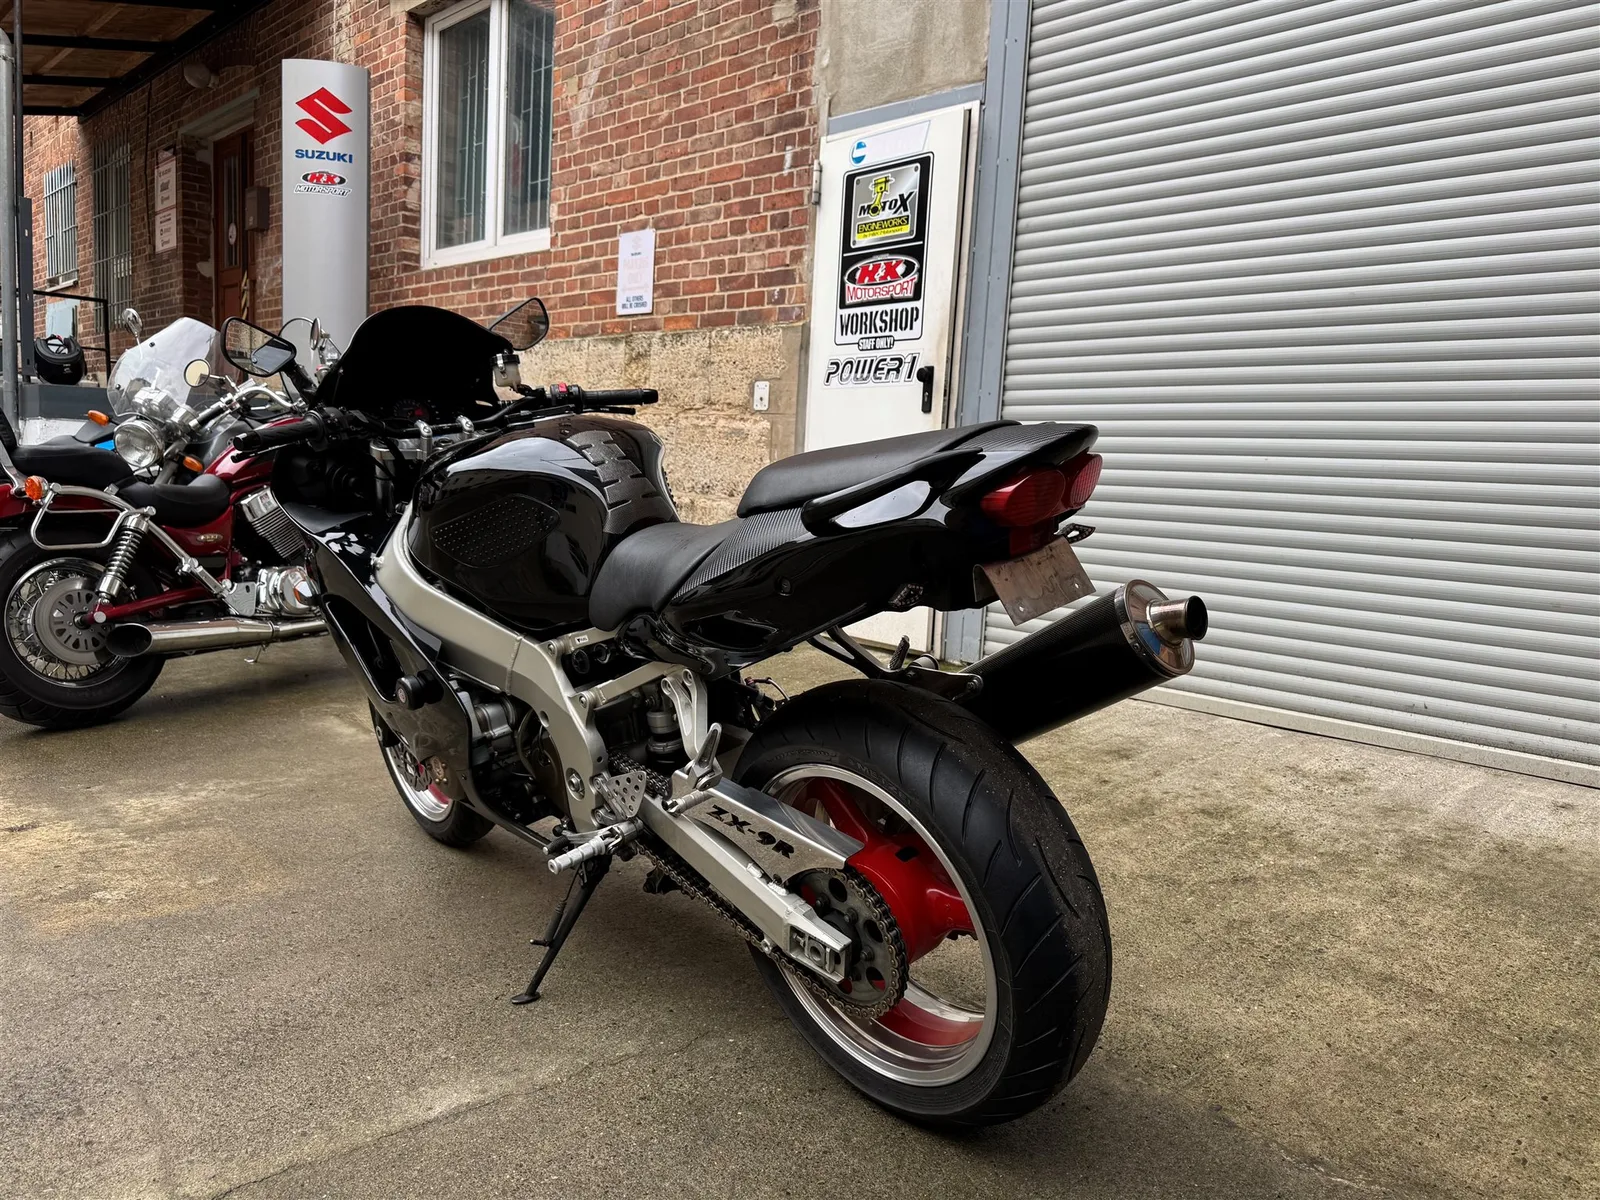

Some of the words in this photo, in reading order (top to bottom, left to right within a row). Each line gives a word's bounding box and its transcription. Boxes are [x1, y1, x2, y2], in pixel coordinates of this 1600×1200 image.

[295, 149, 353, 163] SUZUKI
[295, 185, 350, 196] MOTORSPORT
[858, 216, 908, 233] ENGINEWORKS
[847, 277, 918, 301] MOTORSPORT
[840, 306, 919, 336] WORKSHOP
[858, 338, 875, 350] STAFF
[875, 336, 894, 350] ONLY!
[706, 804, 795, 860] ZX-9R
